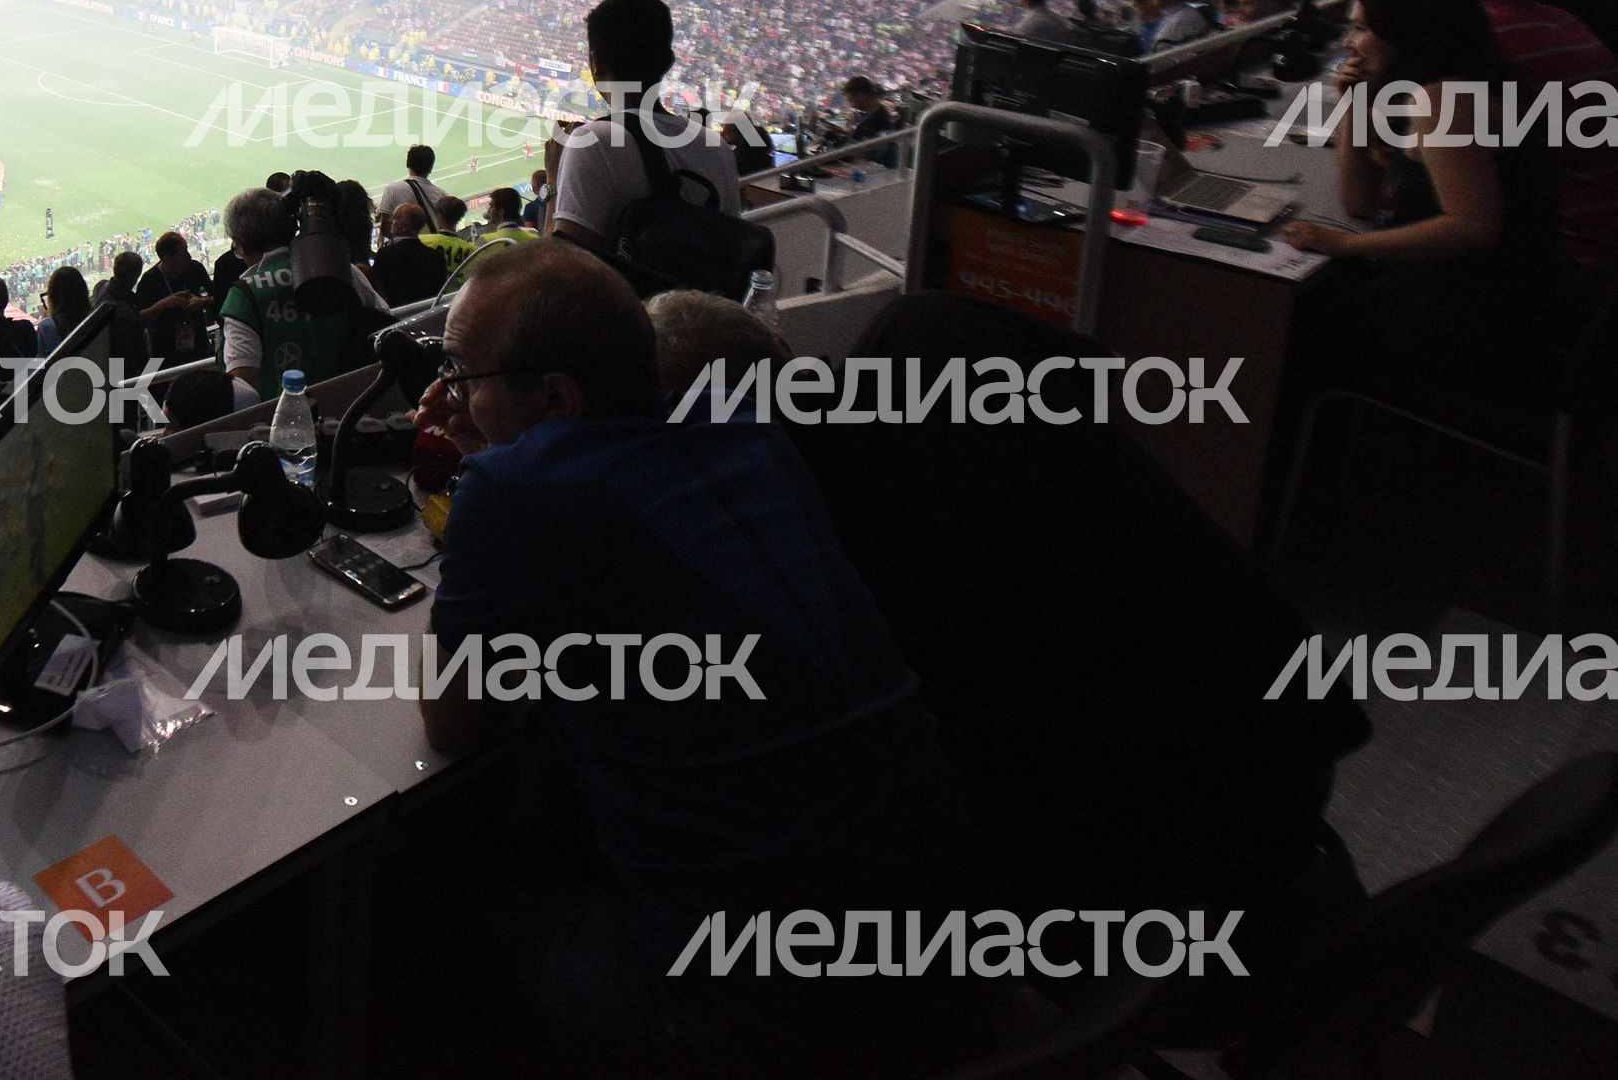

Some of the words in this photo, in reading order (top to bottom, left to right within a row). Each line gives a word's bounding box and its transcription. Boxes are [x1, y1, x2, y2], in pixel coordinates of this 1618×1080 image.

[393, 71, 428, 89] FRANCE
[477, 90, 586, 123] CONGRALATIONS
[74, 867, 127, 909] B
